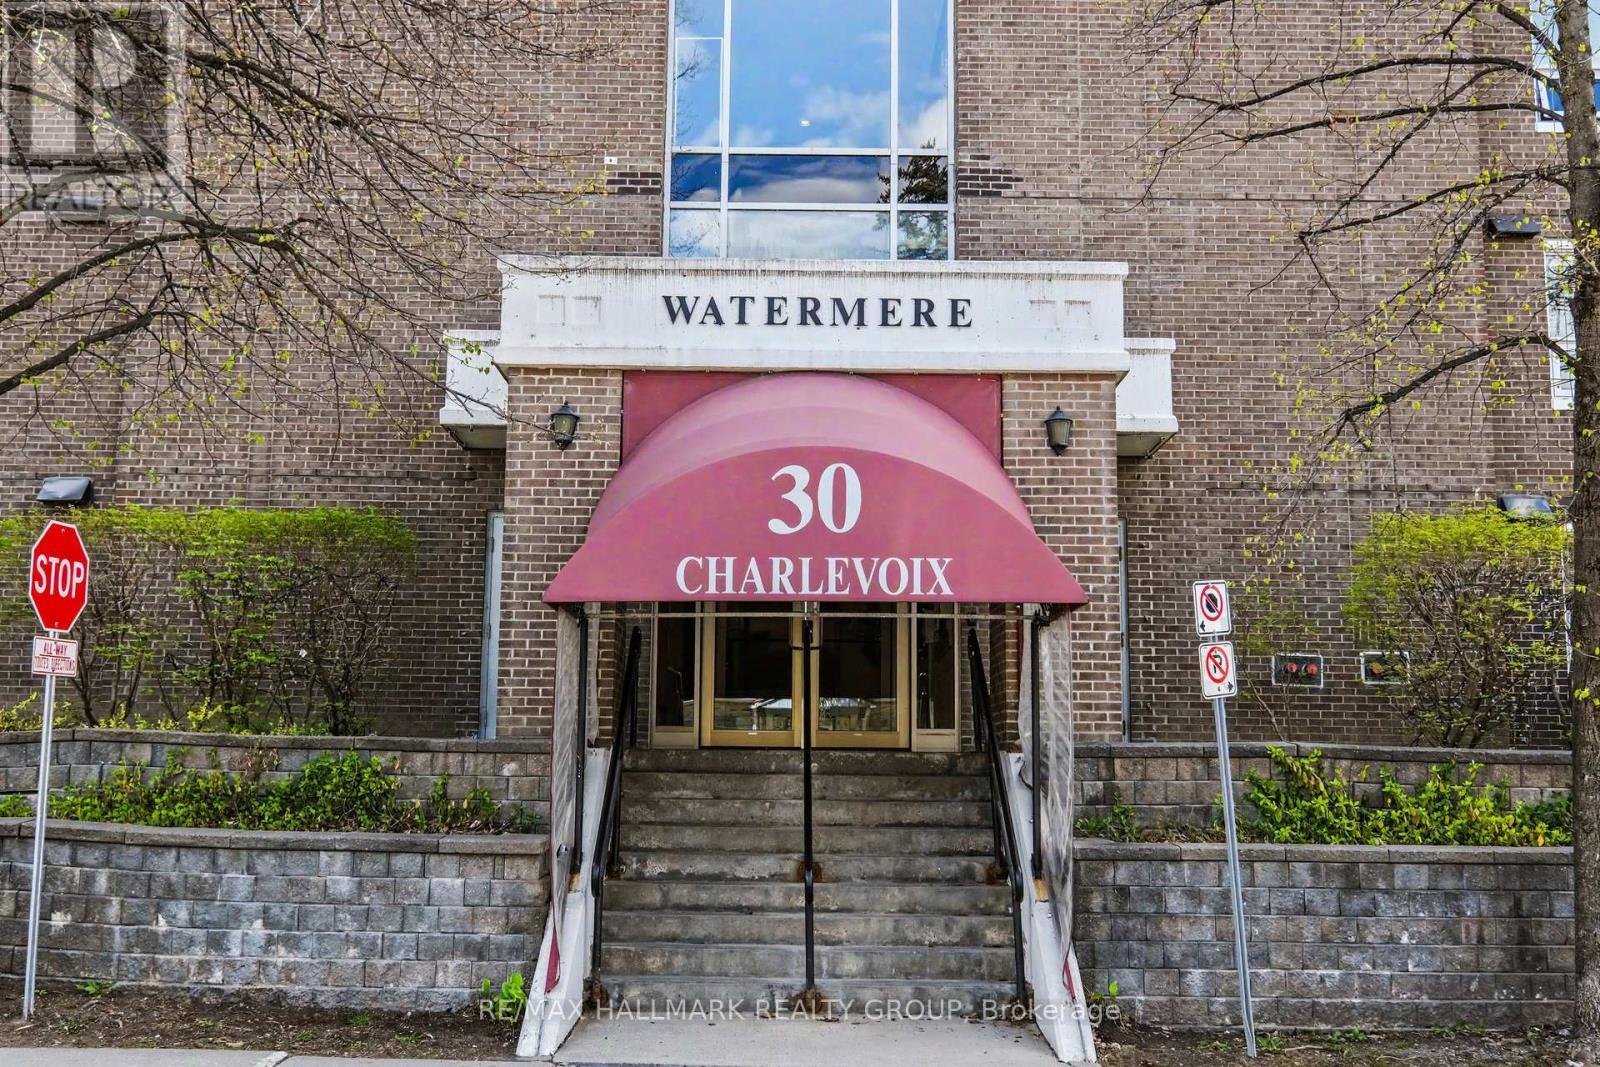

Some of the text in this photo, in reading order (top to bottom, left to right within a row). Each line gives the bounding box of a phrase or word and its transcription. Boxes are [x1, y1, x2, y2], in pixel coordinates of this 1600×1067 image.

[661, 295, 973, 328] WATERMERE
[767, 462, 862, 535] 30
[34, 554, 85, 599] STOP
[675, 556, 955, 596] CHARLEVOIX
[43, 641, 68, 656] ALL-WAY
